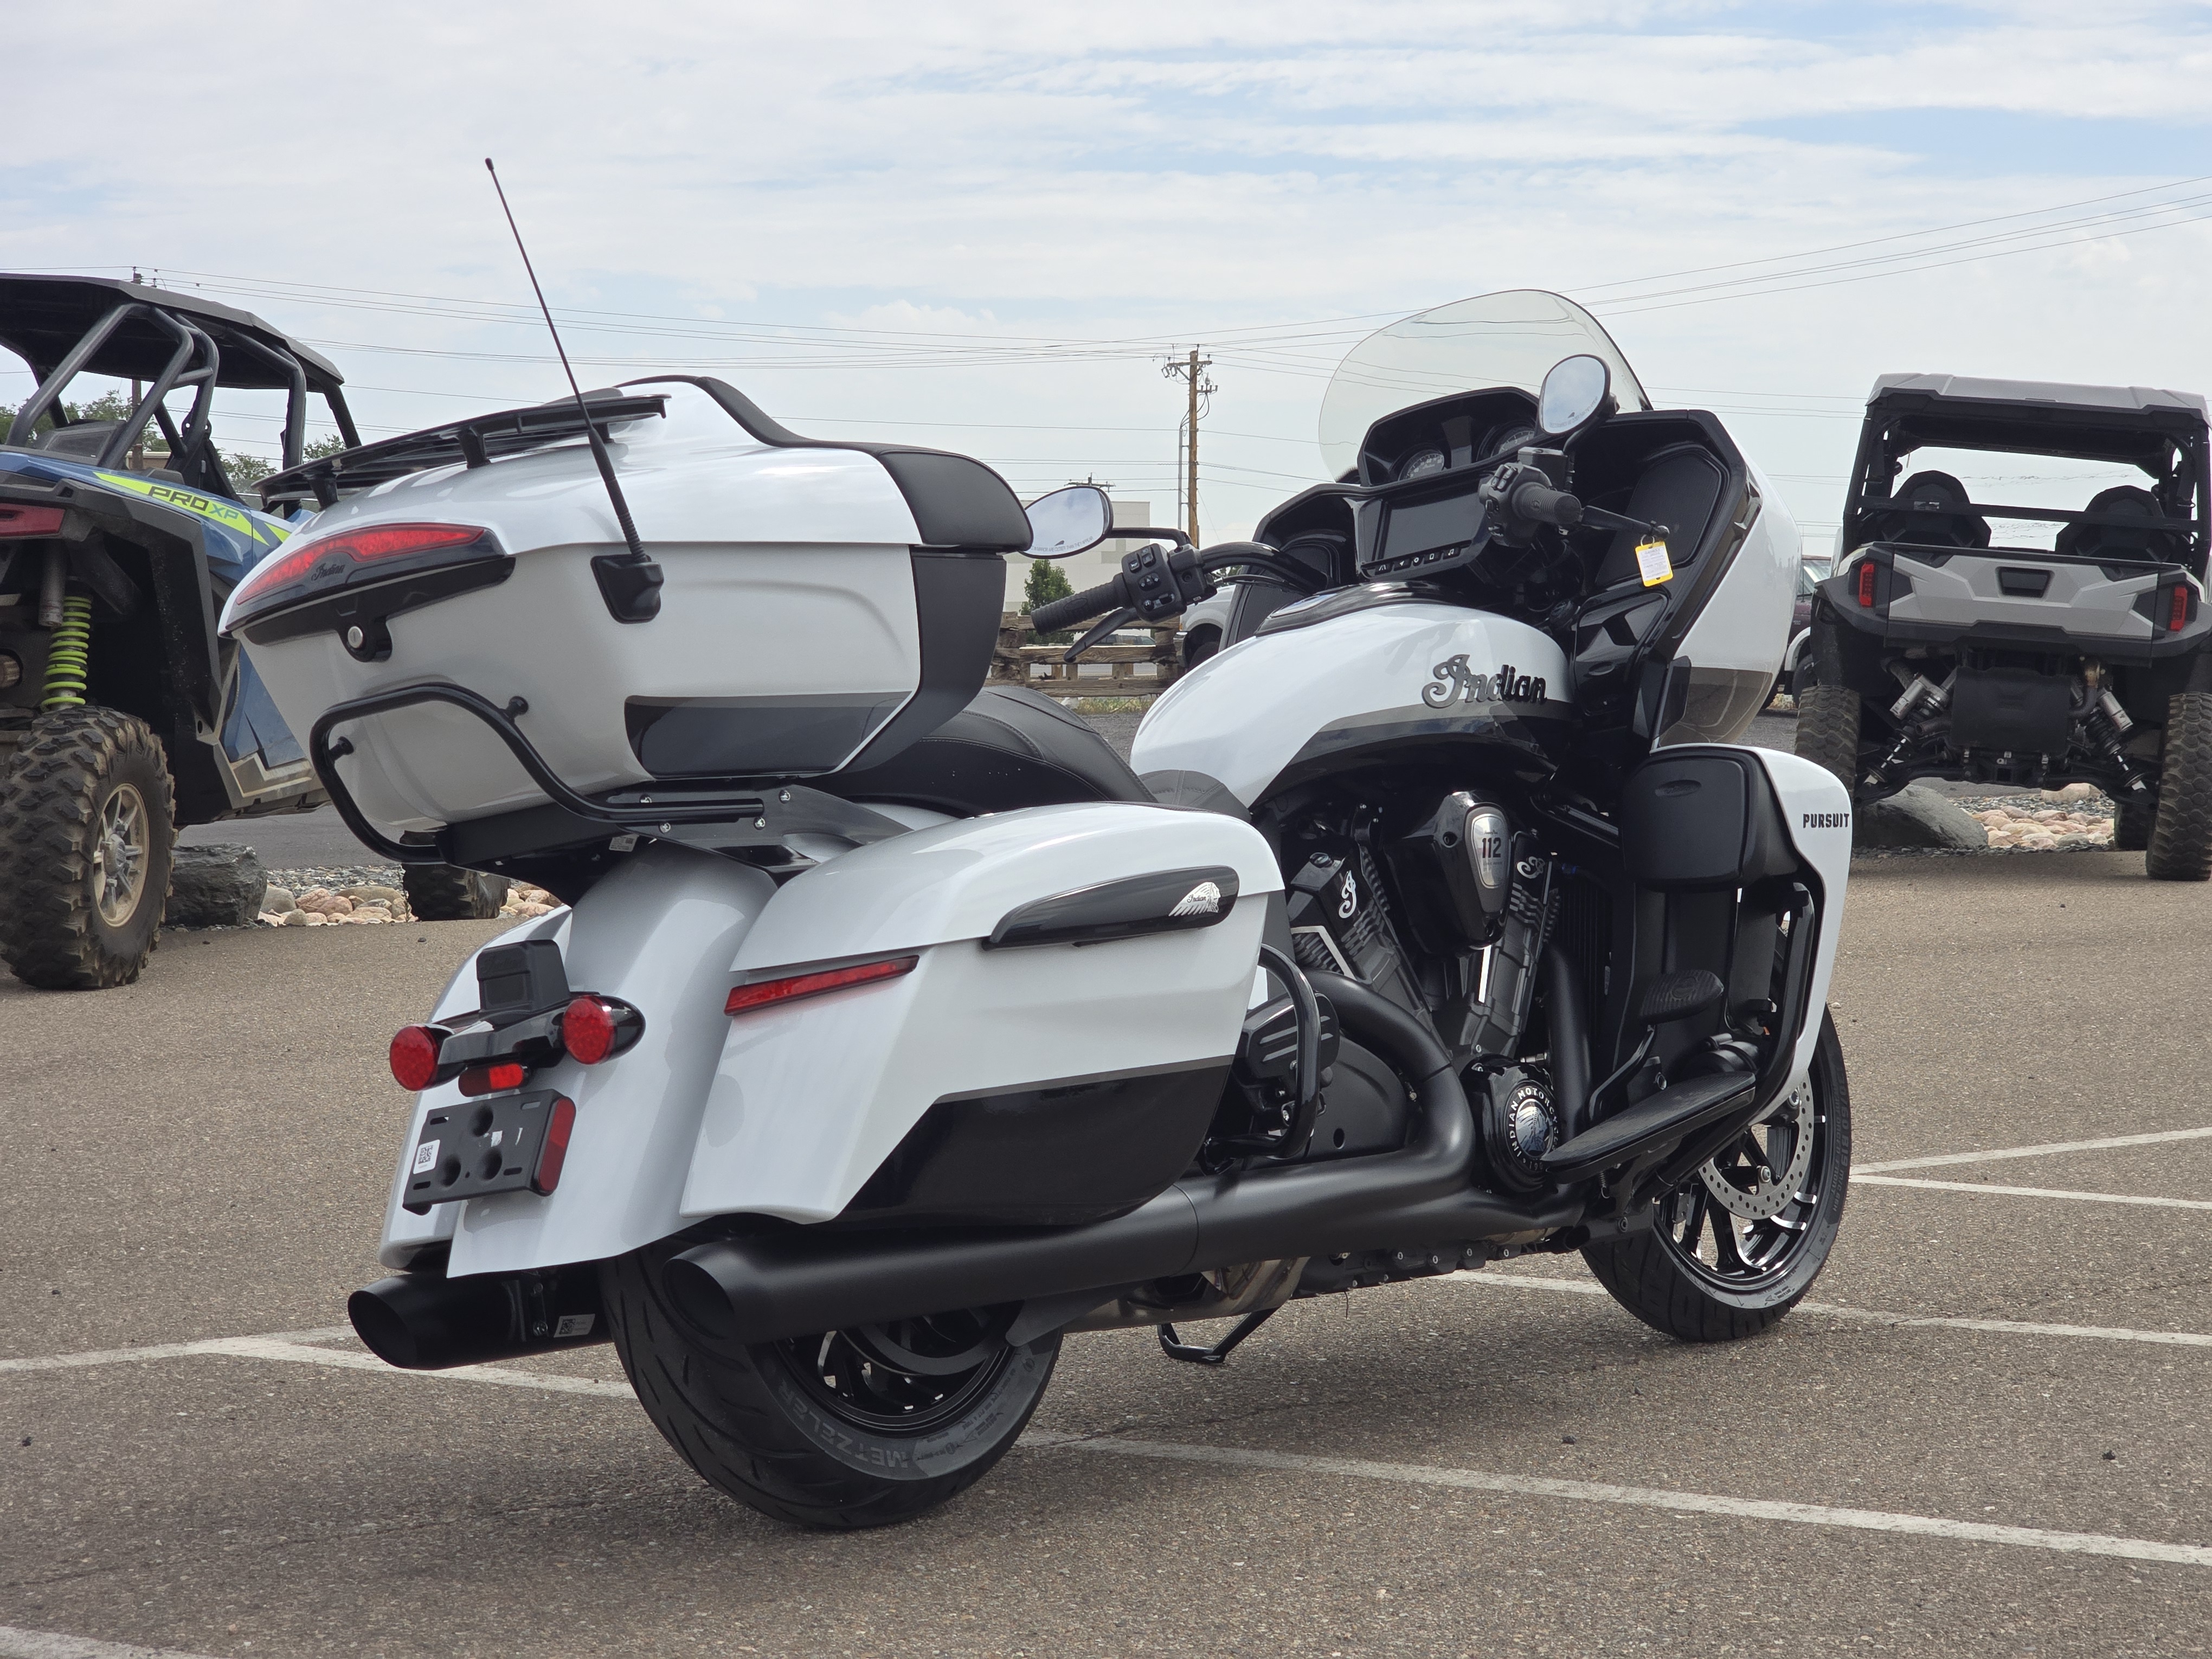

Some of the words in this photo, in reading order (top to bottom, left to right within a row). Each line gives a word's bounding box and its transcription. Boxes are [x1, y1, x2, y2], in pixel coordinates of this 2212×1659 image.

[148, 486, 209, 511] PRO
[209, 503, 239, 519] XP
[311, 563, 345, 582] Indian
[1422, 654, 1548, 709] Indian
[1803, 813, 1849, 829] PURSUIT
[1482, 837, 1502, 859] 112
[1187, 893, 1207, 903] Indian
[1508, 1100, 1522, 1157] INDIAN
[777, 1378, 909, 1469] METZELER
